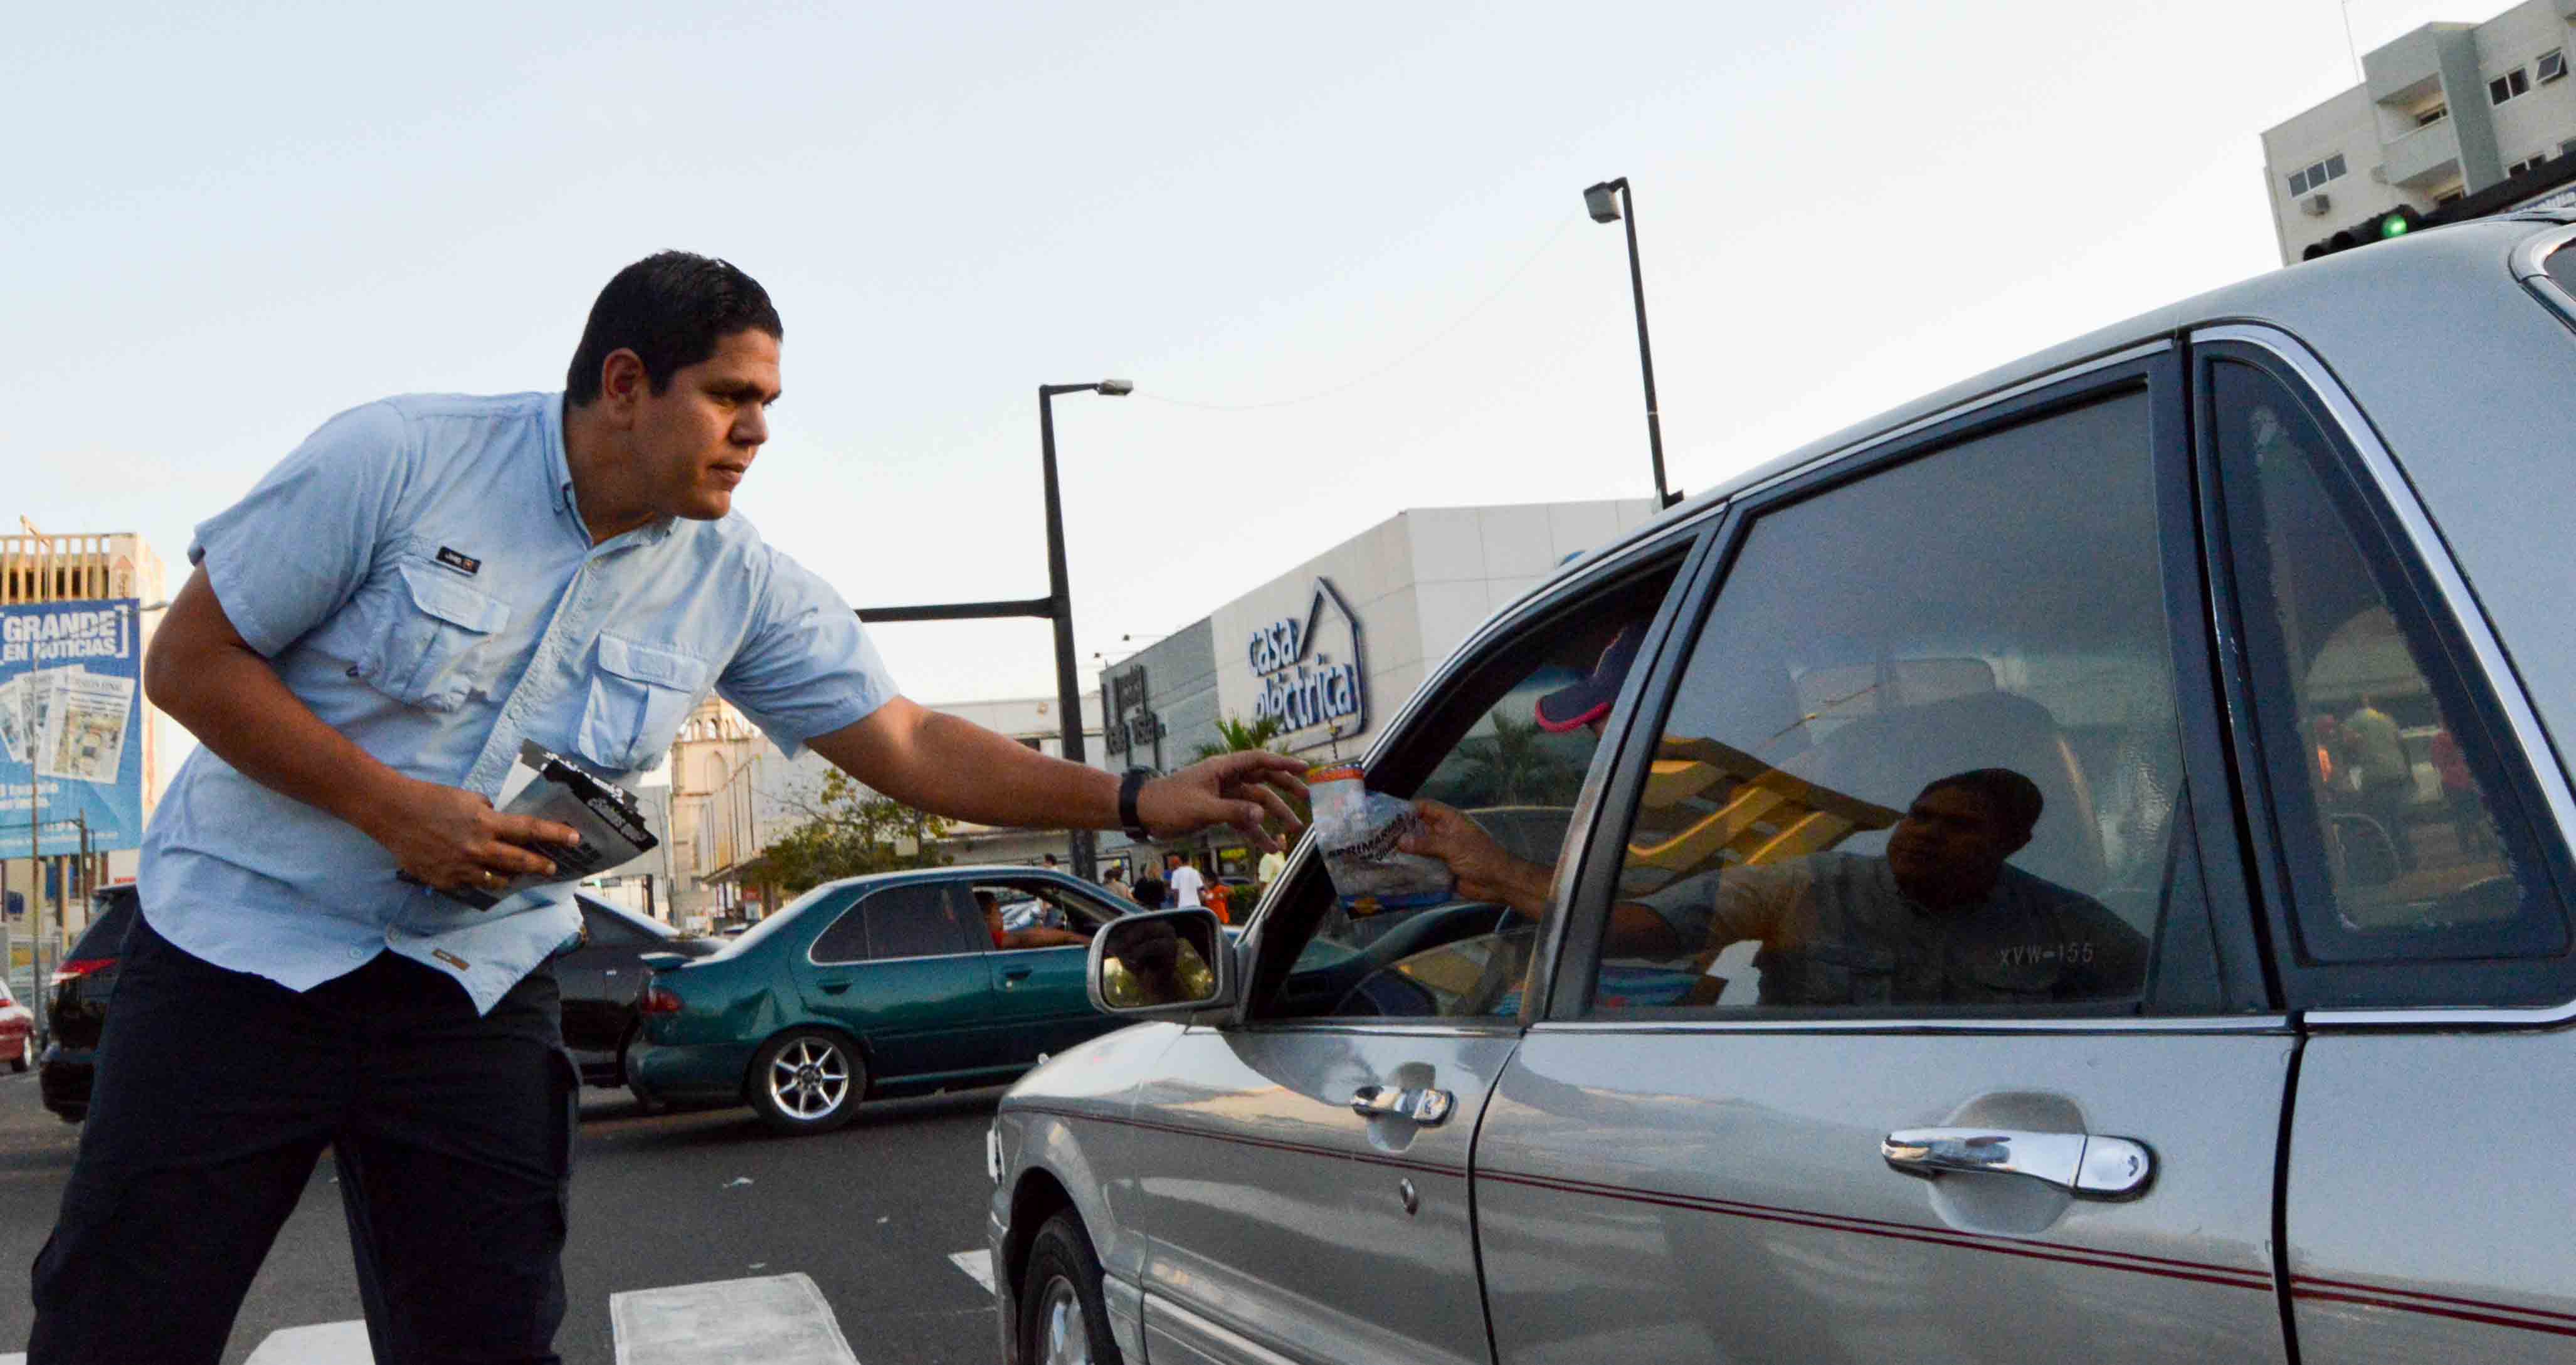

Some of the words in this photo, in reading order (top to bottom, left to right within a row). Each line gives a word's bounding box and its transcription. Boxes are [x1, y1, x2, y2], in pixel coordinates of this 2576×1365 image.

[3, 610, 117, 643] GRANDE
[3, 642, 29, 661] EN
[33, 637, 116, 660] NOTICIAS
